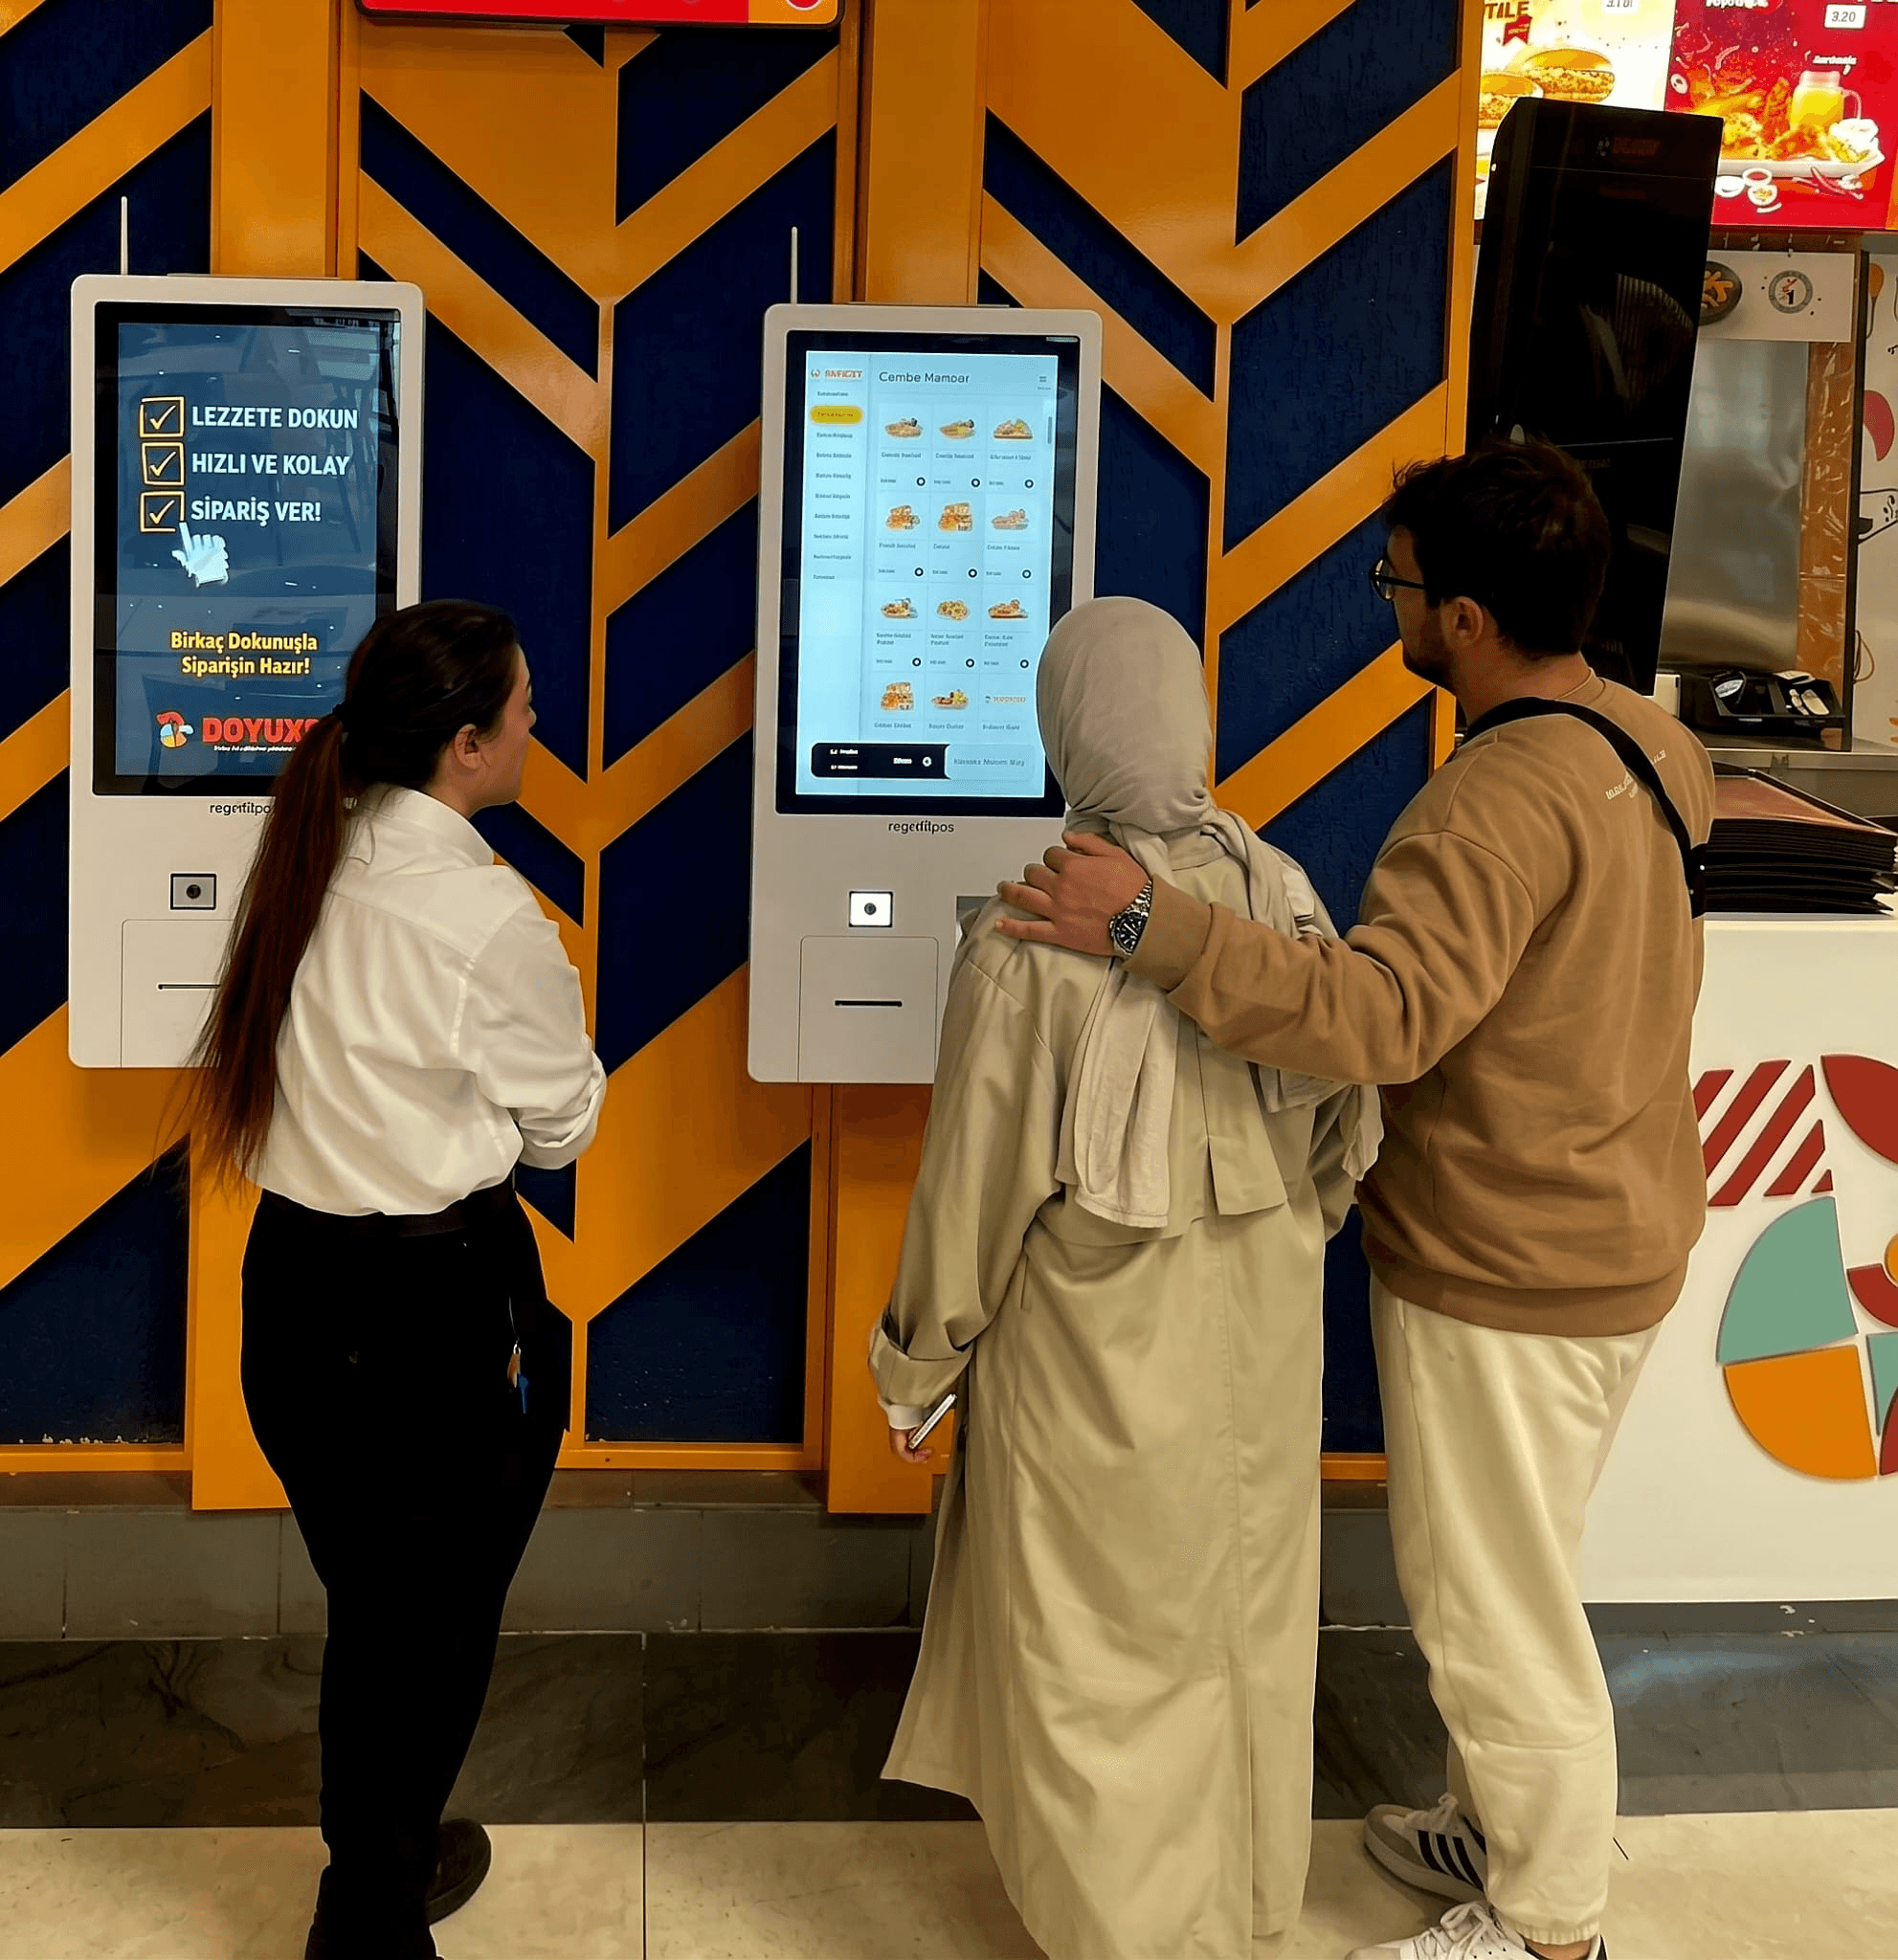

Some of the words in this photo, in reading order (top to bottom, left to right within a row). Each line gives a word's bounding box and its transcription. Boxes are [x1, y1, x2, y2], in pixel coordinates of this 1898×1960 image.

[1832, 11, 1856, 22] 3.20
[192, 407, 282, 427] LEZZETE
[288, 409, 358, 429] DOKUN
[192, 454, 246, 473] HIZLI
[251, 455, 278, 474] VE
[283, 456, 350, 476] KOLAY
[191, 496, 269, 527] SİPARİŞ
[275, 502, 322, 522] VER!
[171, 631, 224, 654] Birkaç
[229, 633, 318, 655] Dokunuşla
[182, 657, 255, 679] Siparişin
[260, 657, 310, 675] Hazır!
[203, 717, 320, 743] DOYUX
